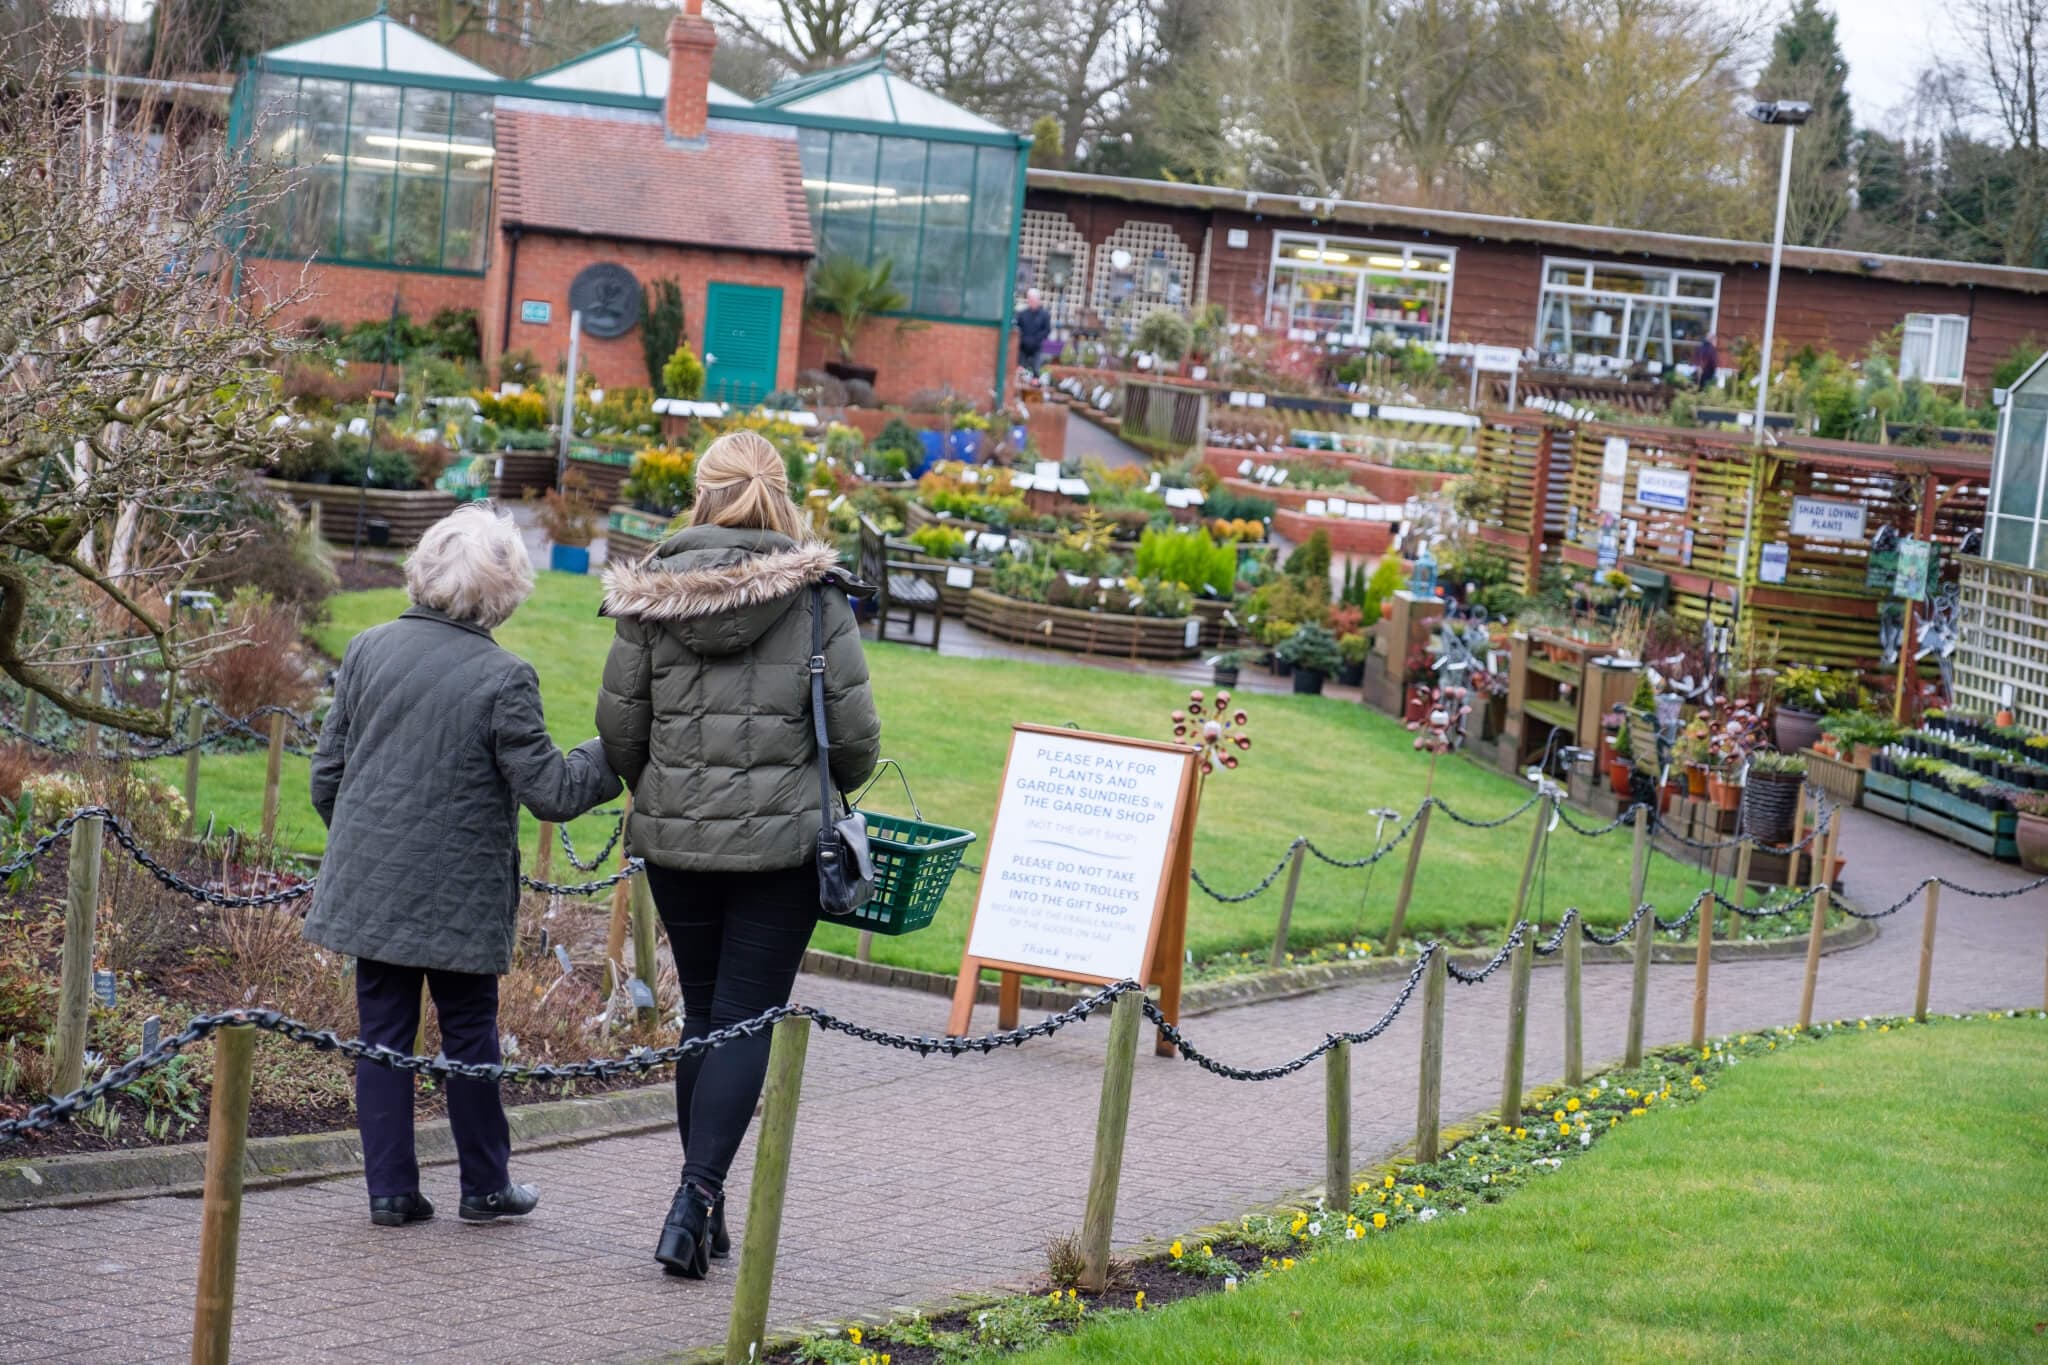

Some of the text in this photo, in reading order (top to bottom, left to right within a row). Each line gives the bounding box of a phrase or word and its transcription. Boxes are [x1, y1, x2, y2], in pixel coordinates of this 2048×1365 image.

[1037, 748, 1157, 776] PLEASE PAY FOR
[1049, 767, 1137, 789] PLANTS AND
[1016, 778, 1164, 809] GARDEN SUNDRIES IN
[1024, 795, 1155, 824] THE GARDEN SHOP
[1013, 855, 1136, 882] PLEASE DO NOT TAKE
[1001, 870, 1139, 901] BASKETS AND TROLLEYS
[1009, 889, 1128, 915] INTO THE GIFT SHOP
